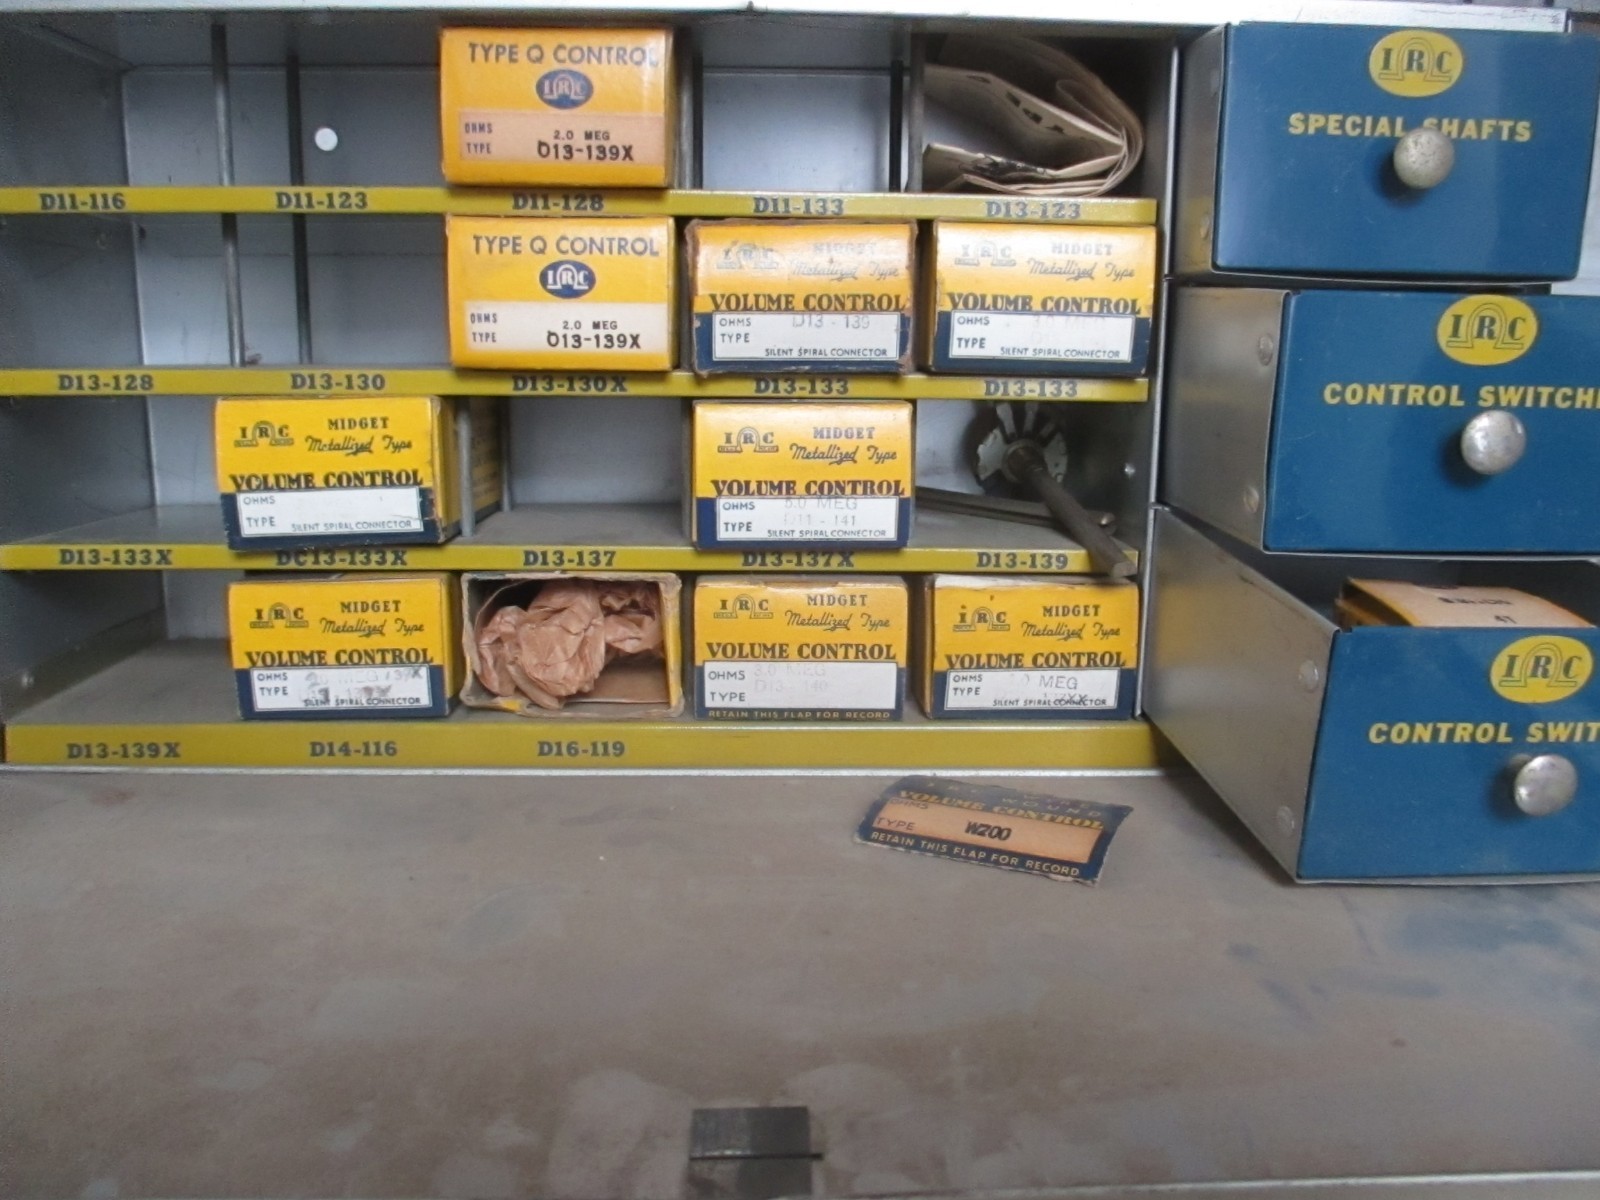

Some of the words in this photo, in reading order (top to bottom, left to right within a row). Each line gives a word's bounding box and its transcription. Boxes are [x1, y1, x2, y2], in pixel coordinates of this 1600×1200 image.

[468, 42, 519, 64] TYPE
[526, 44, 545, 64] Q
[553, 44, 659, 66] CONTROL
[1380, 42, 1453, 79] IRC
[464, 123, 493, 134] OHMS
[553, 130, 574, 141] 2.0
[584, 130, 611, 141] MEG
[1288, 112, 1406, 137] SPECIAL
[466, 143, 491, 154] TYPE
[38, 193, 127, 211] D11-116
[275, 192, 368, 210] D11-123
[512, 192, 604, 212] D11-128
[753, 197, 845, 215] D11-133
[986, 201, 1082, 219] D13-123
[473, 235, 522, 255] TYPE
[530, 235, 548, 255] Q
[556, 237, 660, 256] CONTROL
[1052, 243, 1113, 256] MIDGET
[547, 267, 589, 288] IRC
[1027, 257, 1098, 280] Metallized
[1105, 263, 1136, 281] Type
[709, 293, 795, 311] VOLUME
[803, 294, 906, 311] CONTROL
[947, 292, 1033, 311] VOLUME
[1041, 296, 1141, 315] CONTROL
[470, 313, 497, 324] OHMS
[562, 321, 582, 330] 2.0
[592, 321, 618, 330] MEG
[719, 318, 752, 327] OHMS
[957, 316, 990, 326] OHMS
[1448, 310, 1526, 345] IRC
[472, 332, 497, 343] TYPE
[720, 333, 750, 343] TYPE
[956, 337, 986, 349] TYPE
[765, 348, 793, 357] SILENT
[798, 348, 828, 357] SPIRAL
[831, 348, 887, 357] CONNECTOR
[1000, 347, 1028, 356] SILENT
[1032, 348, 1061, 357] SPIRAL
[1064, 349, 1121, 359] CONNECTOR
[57, 374, 154, 391] D13-128
[290, 373, 386, 391] D13-130
[512, 376, 628, 393] D13-130X
[755, 378, 849, 395] D13-133
[984, 380, 1078, 397] D13-133
[1323, 383, 1465, 407] CONTROL
[239, 423, 290, 440] IRC
[328, 417, 390, 430] MIDGET
[724, 430, 774, 446] IRC
[813, 427, 876, 440] MIDGET
[305, 435, 374, 456] Metallized
[382, 435, 413, 453] Type
[789, 443, 859, 465] Metallized
[866, 445, 897, 464] Type
[229, 472, 315, 491] VOLUME
[323, 469, 424, 488] CONTROL
[710, 479, 797, 496] VOLUME
[805, 480, 905, 497] CONTROL
[243, 496, 276, 506] OHMS
[723, 501, 756, 511] OHMS
[246, 517, 276, 528] TYPE
[291, 523, 320, 532] SILENT
[323, 522, 353, 531] SPIRAL
[355, 520, 412, 530] CONNECTOR
[724, 522, 753, 532] TYPE
[768, 529, 795, 537] SILENT
[799, 529, 829, 537] SPIRAL
[830, 529, 887, 537] CONNECTOR
[59, 549, 173, 566] D13-133X
[276, 550, 408, 566] DC13-133X
[523, 551, 617, 567] D13-137
[742, 552, 855, 567] D13-137X
[976, 552, 1068, 569] D13-139
[340, 600, 401, 613] MIDGET
[719, 598, 769, 612] IRC
[807, 594, 868, 607] MIDGET
[255, 606, 304, 621] IRC
[959, 610, 1007, 624] IRC
[1042, 604, 1101, 617] MIDGET
[320, 618, 386, 637] Metallized
[395, 618, 425, 636] Type
[785, 610, 852, 631] Metallized
[861, 613, 890, 631] Type
[1021, 621, 1084, 640] Metallized
[1093, 623, 1121, 639] Type
[245, 650, 328, 667] VOLUME
[335, 648, 434, 666] CONTROL
[706, 642, 789, 659] VOLUME
[797, 644, 896, 660] CONTROL
[945, 654, 1024, 669] VOLUME
[1032, 651, 1126, 668] CONTROL
[1503, 650, 1582, 682] IRC
[257, 673, 288, 682] OHMS
[708, 671, 745, 681] OHMS
[953, 674, 983, 683] OHMS
[1039, 675, 1078, 690] MEG
[259, 687, 289, 696] TYPE
[710, 692, 745, 702] TYPE
[953, 687, 980, 696] TYPE
[335, 697, 364, 706] SPIRAL
[366, 697, 421, 706] CONNECTOR
[784, 711, 811, 719] FLAP
[816, 711, 839, 719] FOR
[846, 711, 890, 719] RECORD
[1369, 722, 1513, 744] CONTROL
[67, 743, 181, 760] D13-139X
[309, 741, 397, 757] D14-116
[537, 741, 626, 757] D16-119
[899, 790, 986, 812] VOLUME
[992, 805, 1105, 829] CONTROL
[876, 817, 915, 831] TYPE
[964, 821, 1012, 841] W200
[871, 831, 913, 846] RETAIN
[920, 839, 947, 853] THIS
[953, 846, 986, 860] FLAP
[990, 853, 1018, 866] FOR
[1025, 859, 1080, 876] RECORD
